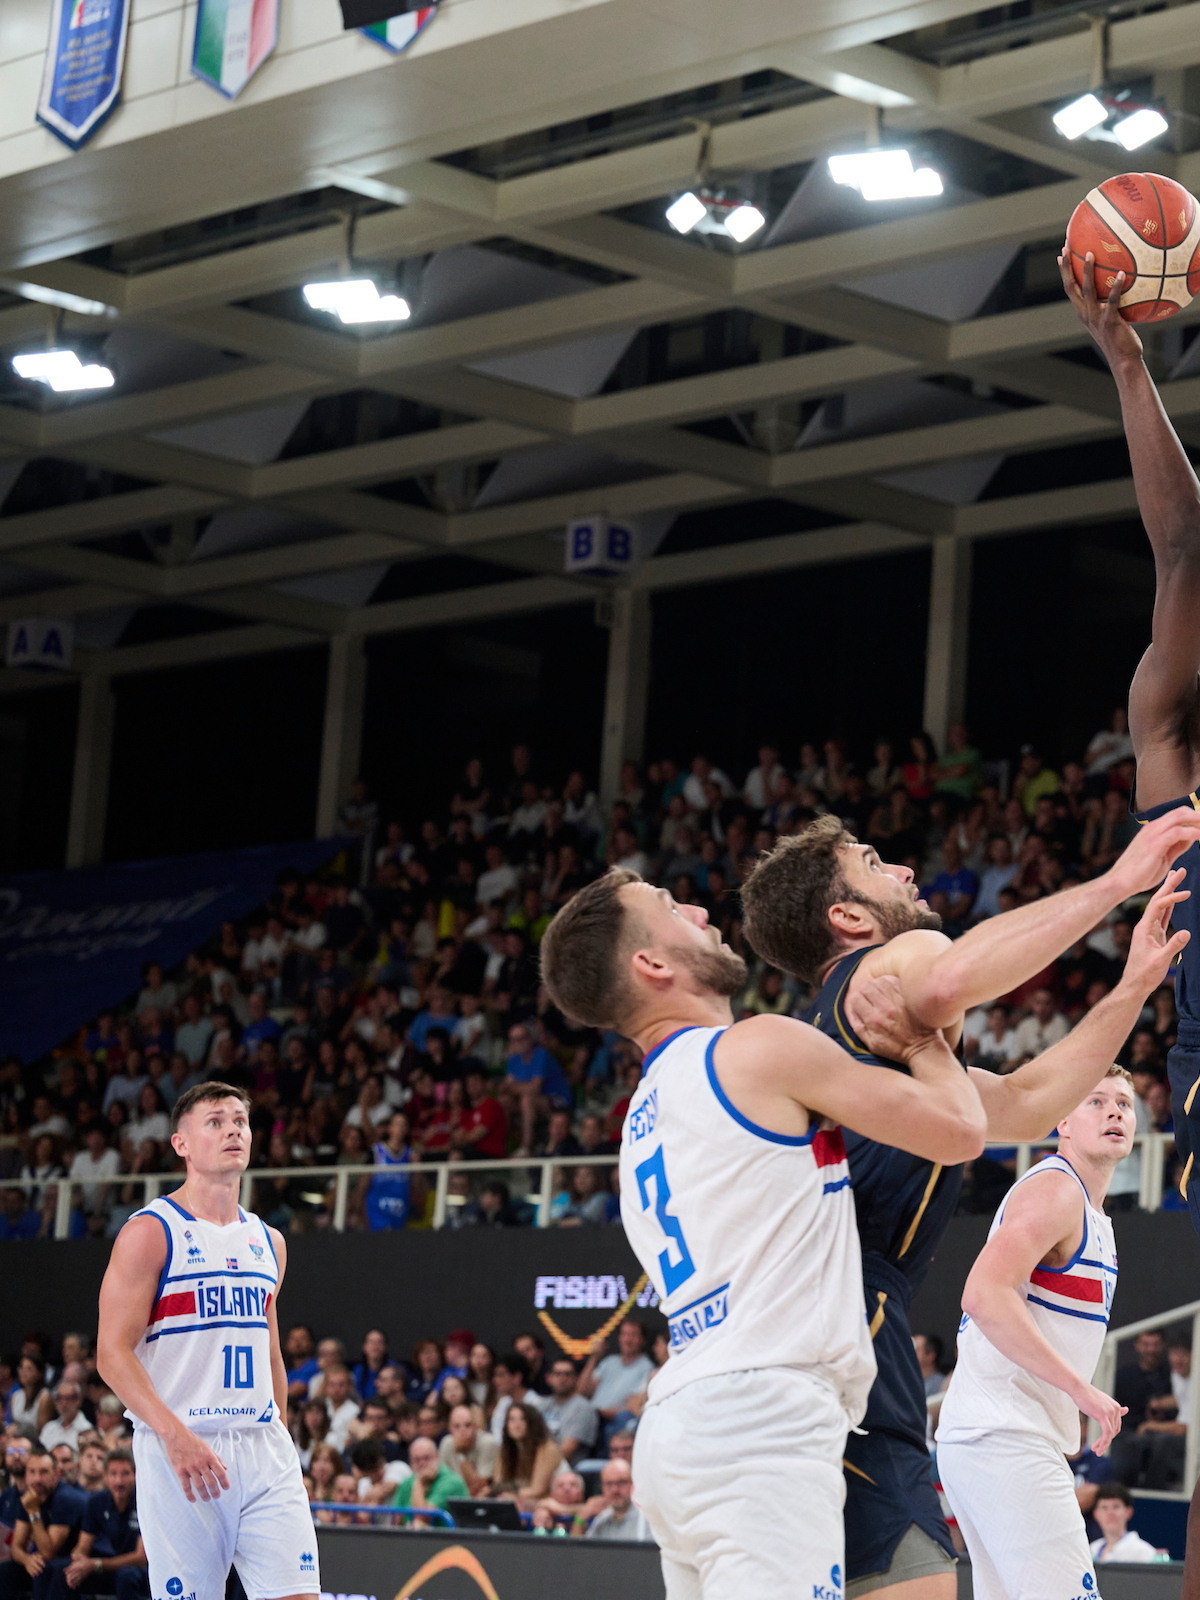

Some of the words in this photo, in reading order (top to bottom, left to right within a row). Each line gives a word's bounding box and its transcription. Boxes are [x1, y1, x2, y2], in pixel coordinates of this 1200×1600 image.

[573, 526, 593, 561] B
[607, 526, 632, 561] B
[13, 627, 28, 655] A
[41, 627, 64, 658] A
[634, 1142, 697, 1298] 3
[222, 1344, 254, 1389] 10
[188, 1407, 257, 1417] ICELANDAIR
